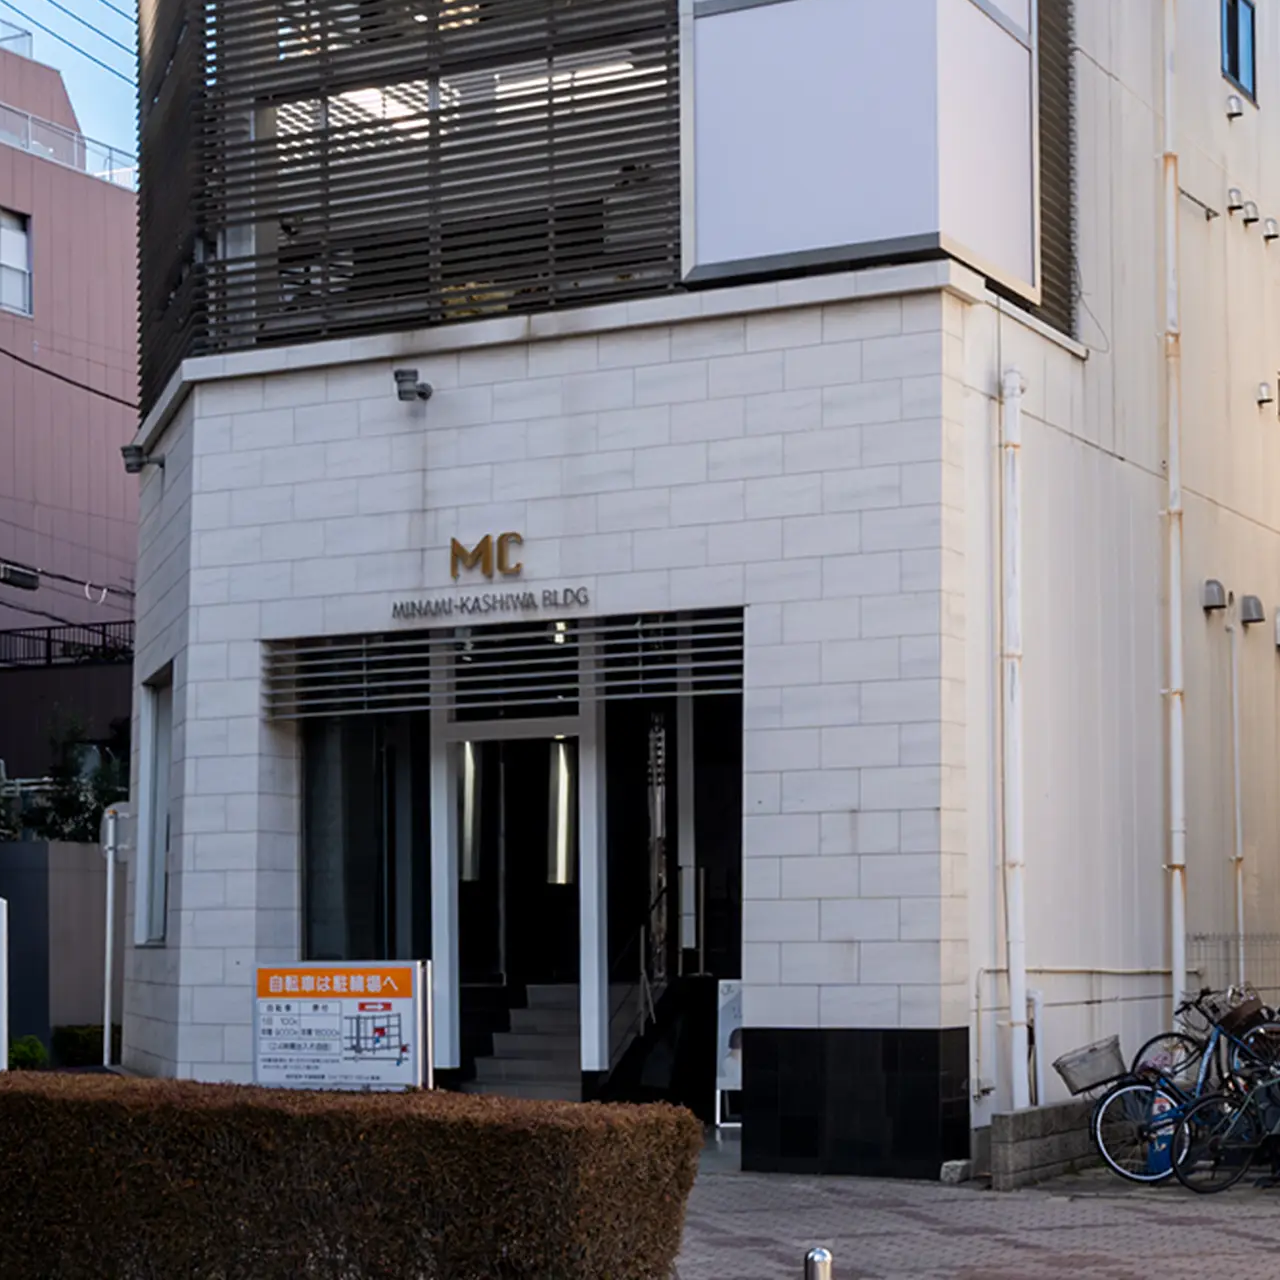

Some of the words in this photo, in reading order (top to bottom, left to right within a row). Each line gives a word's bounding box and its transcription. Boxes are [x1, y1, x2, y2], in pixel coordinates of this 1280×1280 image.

[449, 531, 524, 581] MC
[392, 590, 538, 620] MINAMI-KASHIWA
[542, 586, 590, 610] BLDG
[269, 974, 399, 993] 自転車は駐輪場へ
